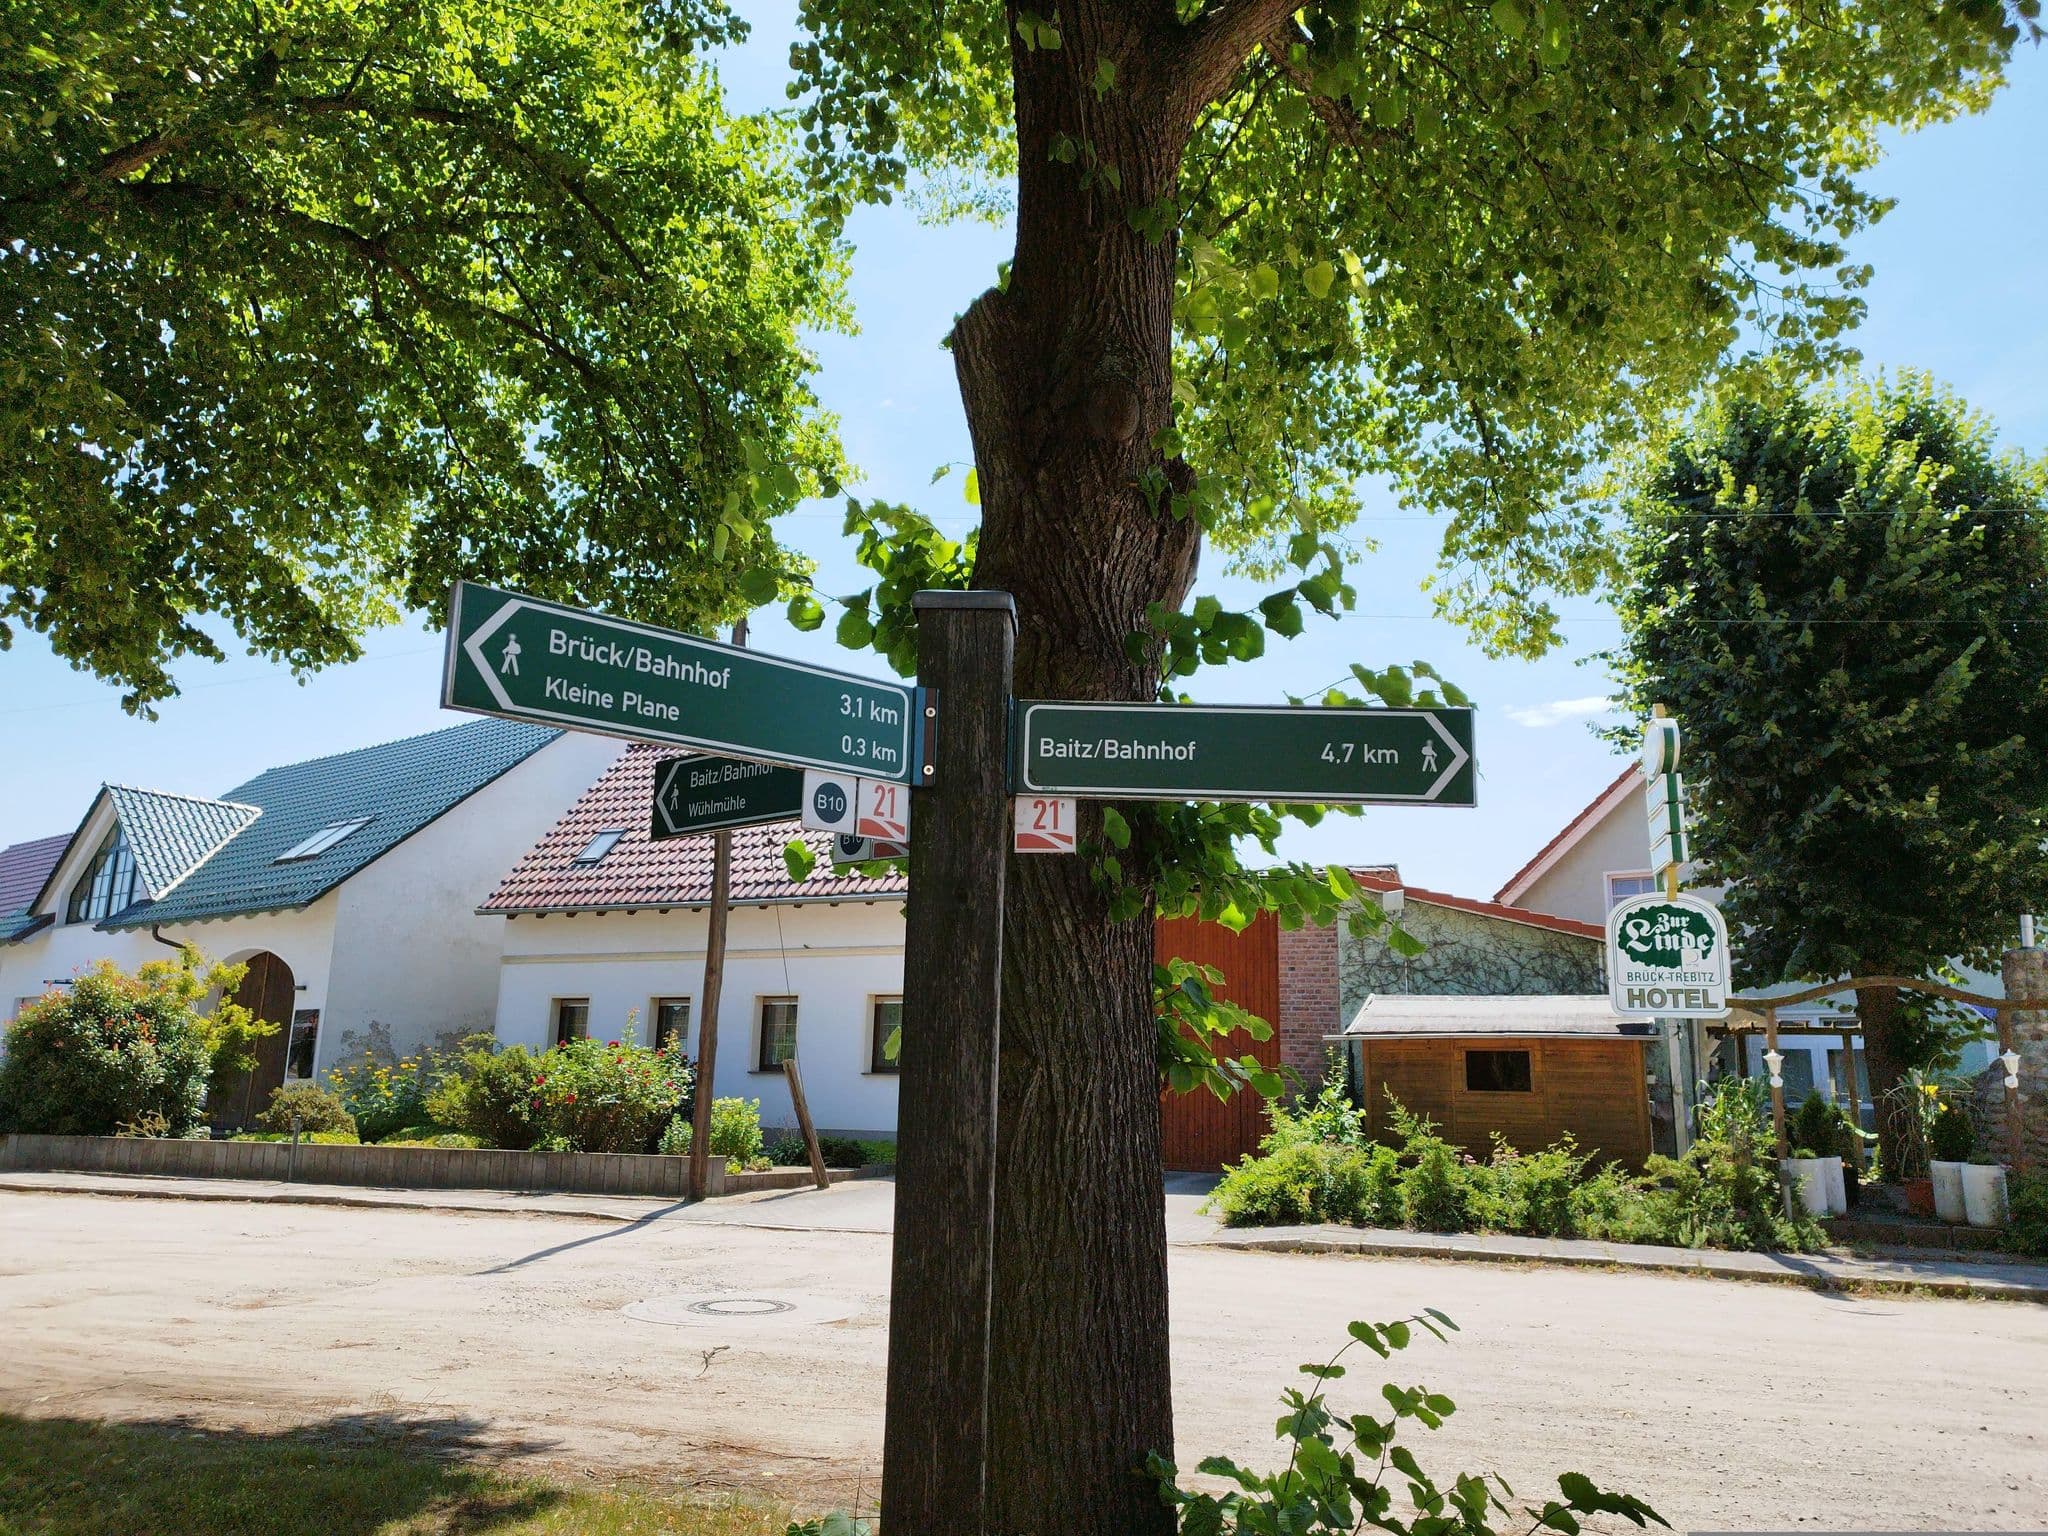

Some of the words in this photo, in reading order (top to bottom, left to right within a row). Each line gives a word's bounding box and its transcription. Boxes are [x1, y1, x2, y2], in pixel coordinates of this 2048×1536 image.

[549, 629, 730, 690] Brück/Bahnhof
[840, 694, 863, 718] 3,1
[870, 700, 898, 725] km
[545, 676, 614, 709] Kleine
[622, 691, 680, 721] Plane
[872, 740, 897, 763] km
[1039, 737, 1196, 761] Baitz/Bahnhof
[1320, 742, 1355, 764] 4,7
[1363, 743, 1399, 764] km
[688, 795, 746, 817] Wühlmühle
[817, 794, 844, 812] B10
[873, 784, 896, 819] 21
[1033, 799, 1059, 830] 21
[1625, 918, 1711, 952] Linde
[1656, 912, 1690, 932] Zur
[1627, 987, 1719, 1009] HOTEL
